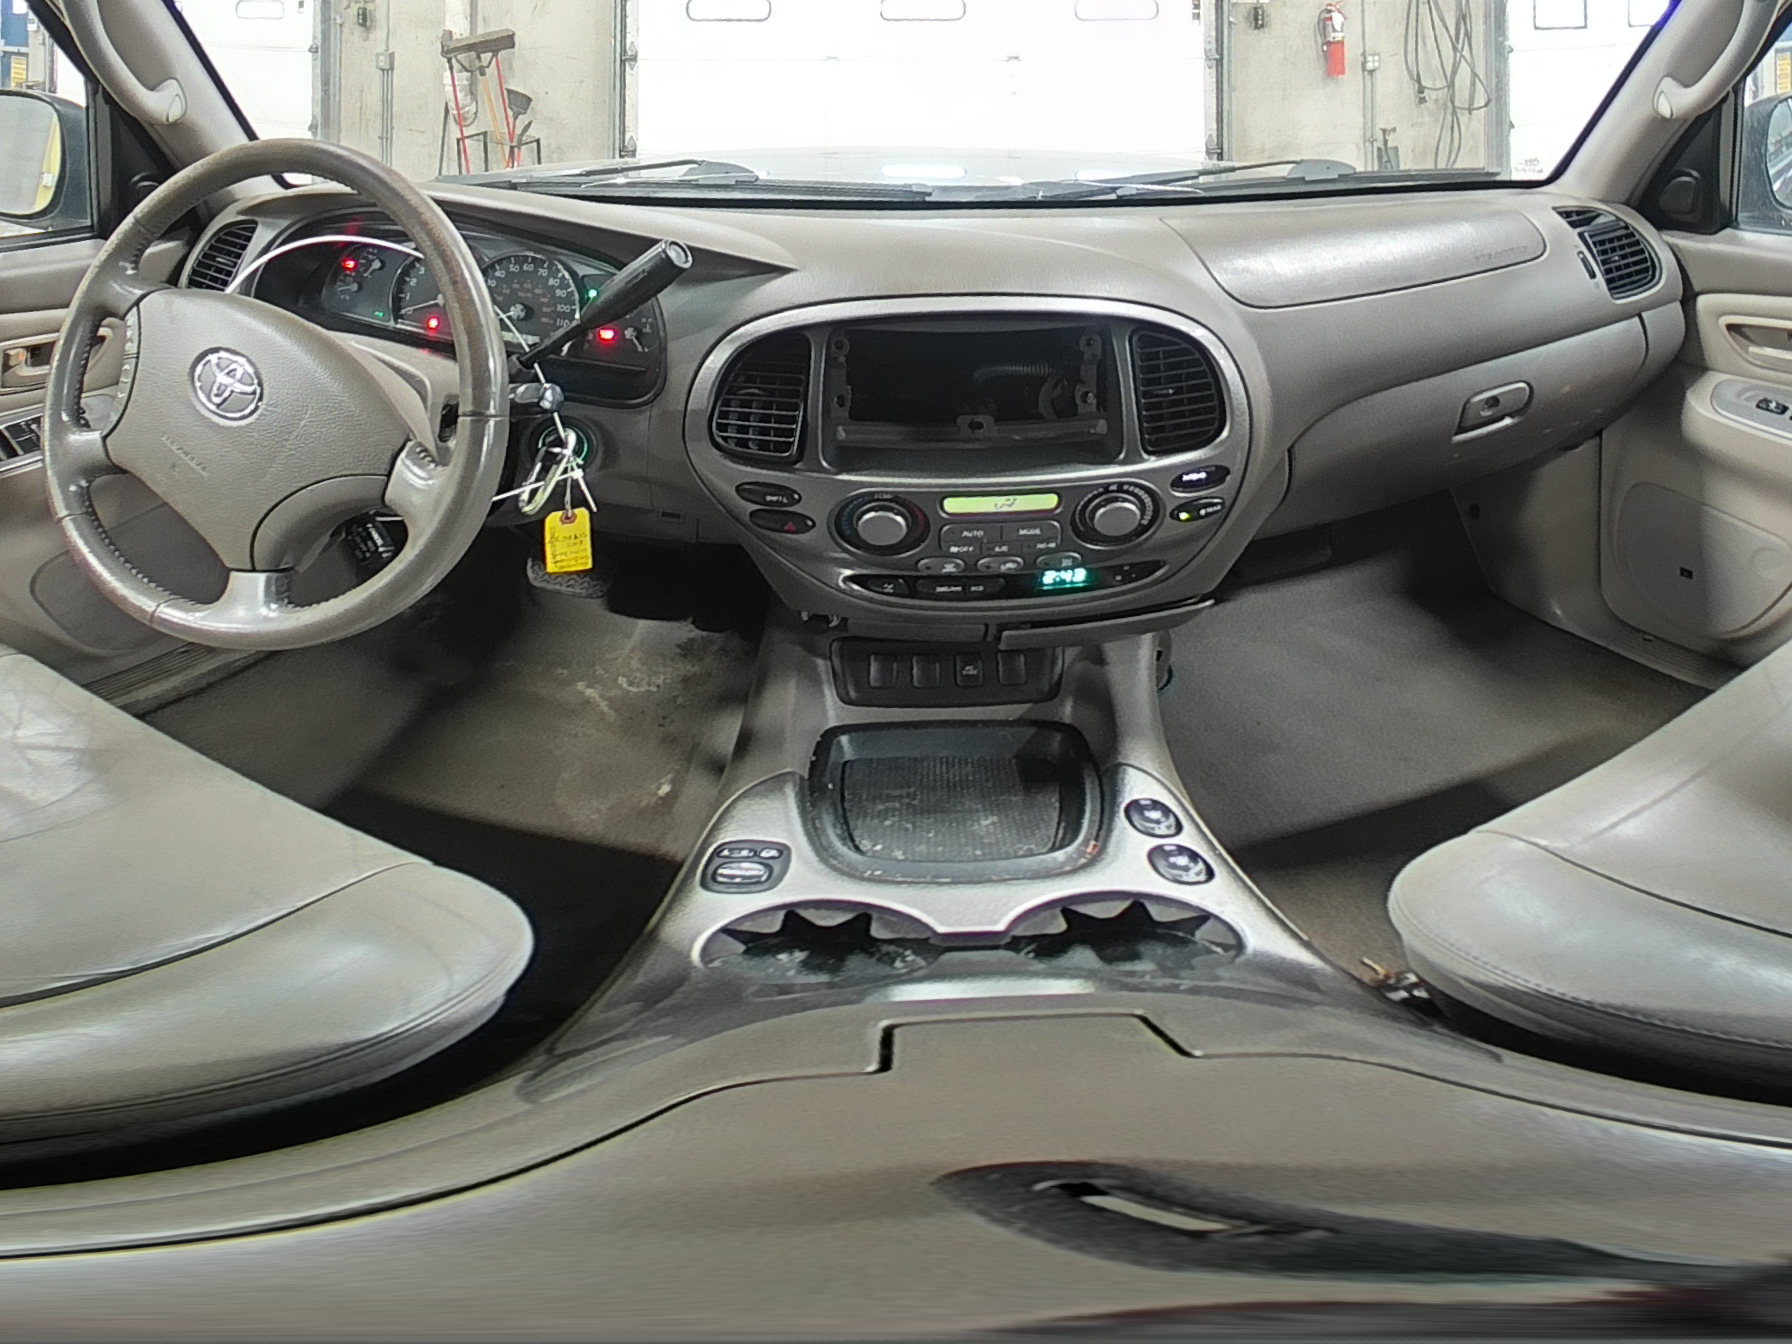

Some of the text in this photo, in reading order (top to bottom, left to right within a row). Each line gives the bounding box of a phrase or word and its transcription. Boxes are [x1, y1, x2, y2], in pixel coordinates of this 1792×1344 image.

[509, 264, 520, 273] 50
[523, 263, 535, 271] 60
[494, 269, 507, 278] 40
[537, 268, 548, 277] 70
[548, 277, 560, 287] 80
[555, 289, 567, 298] 90
[556, 304, 571, 313] 100
[961, 530, 985, 538] AUTO
[1041, 567, 1088, 585] 2:43
